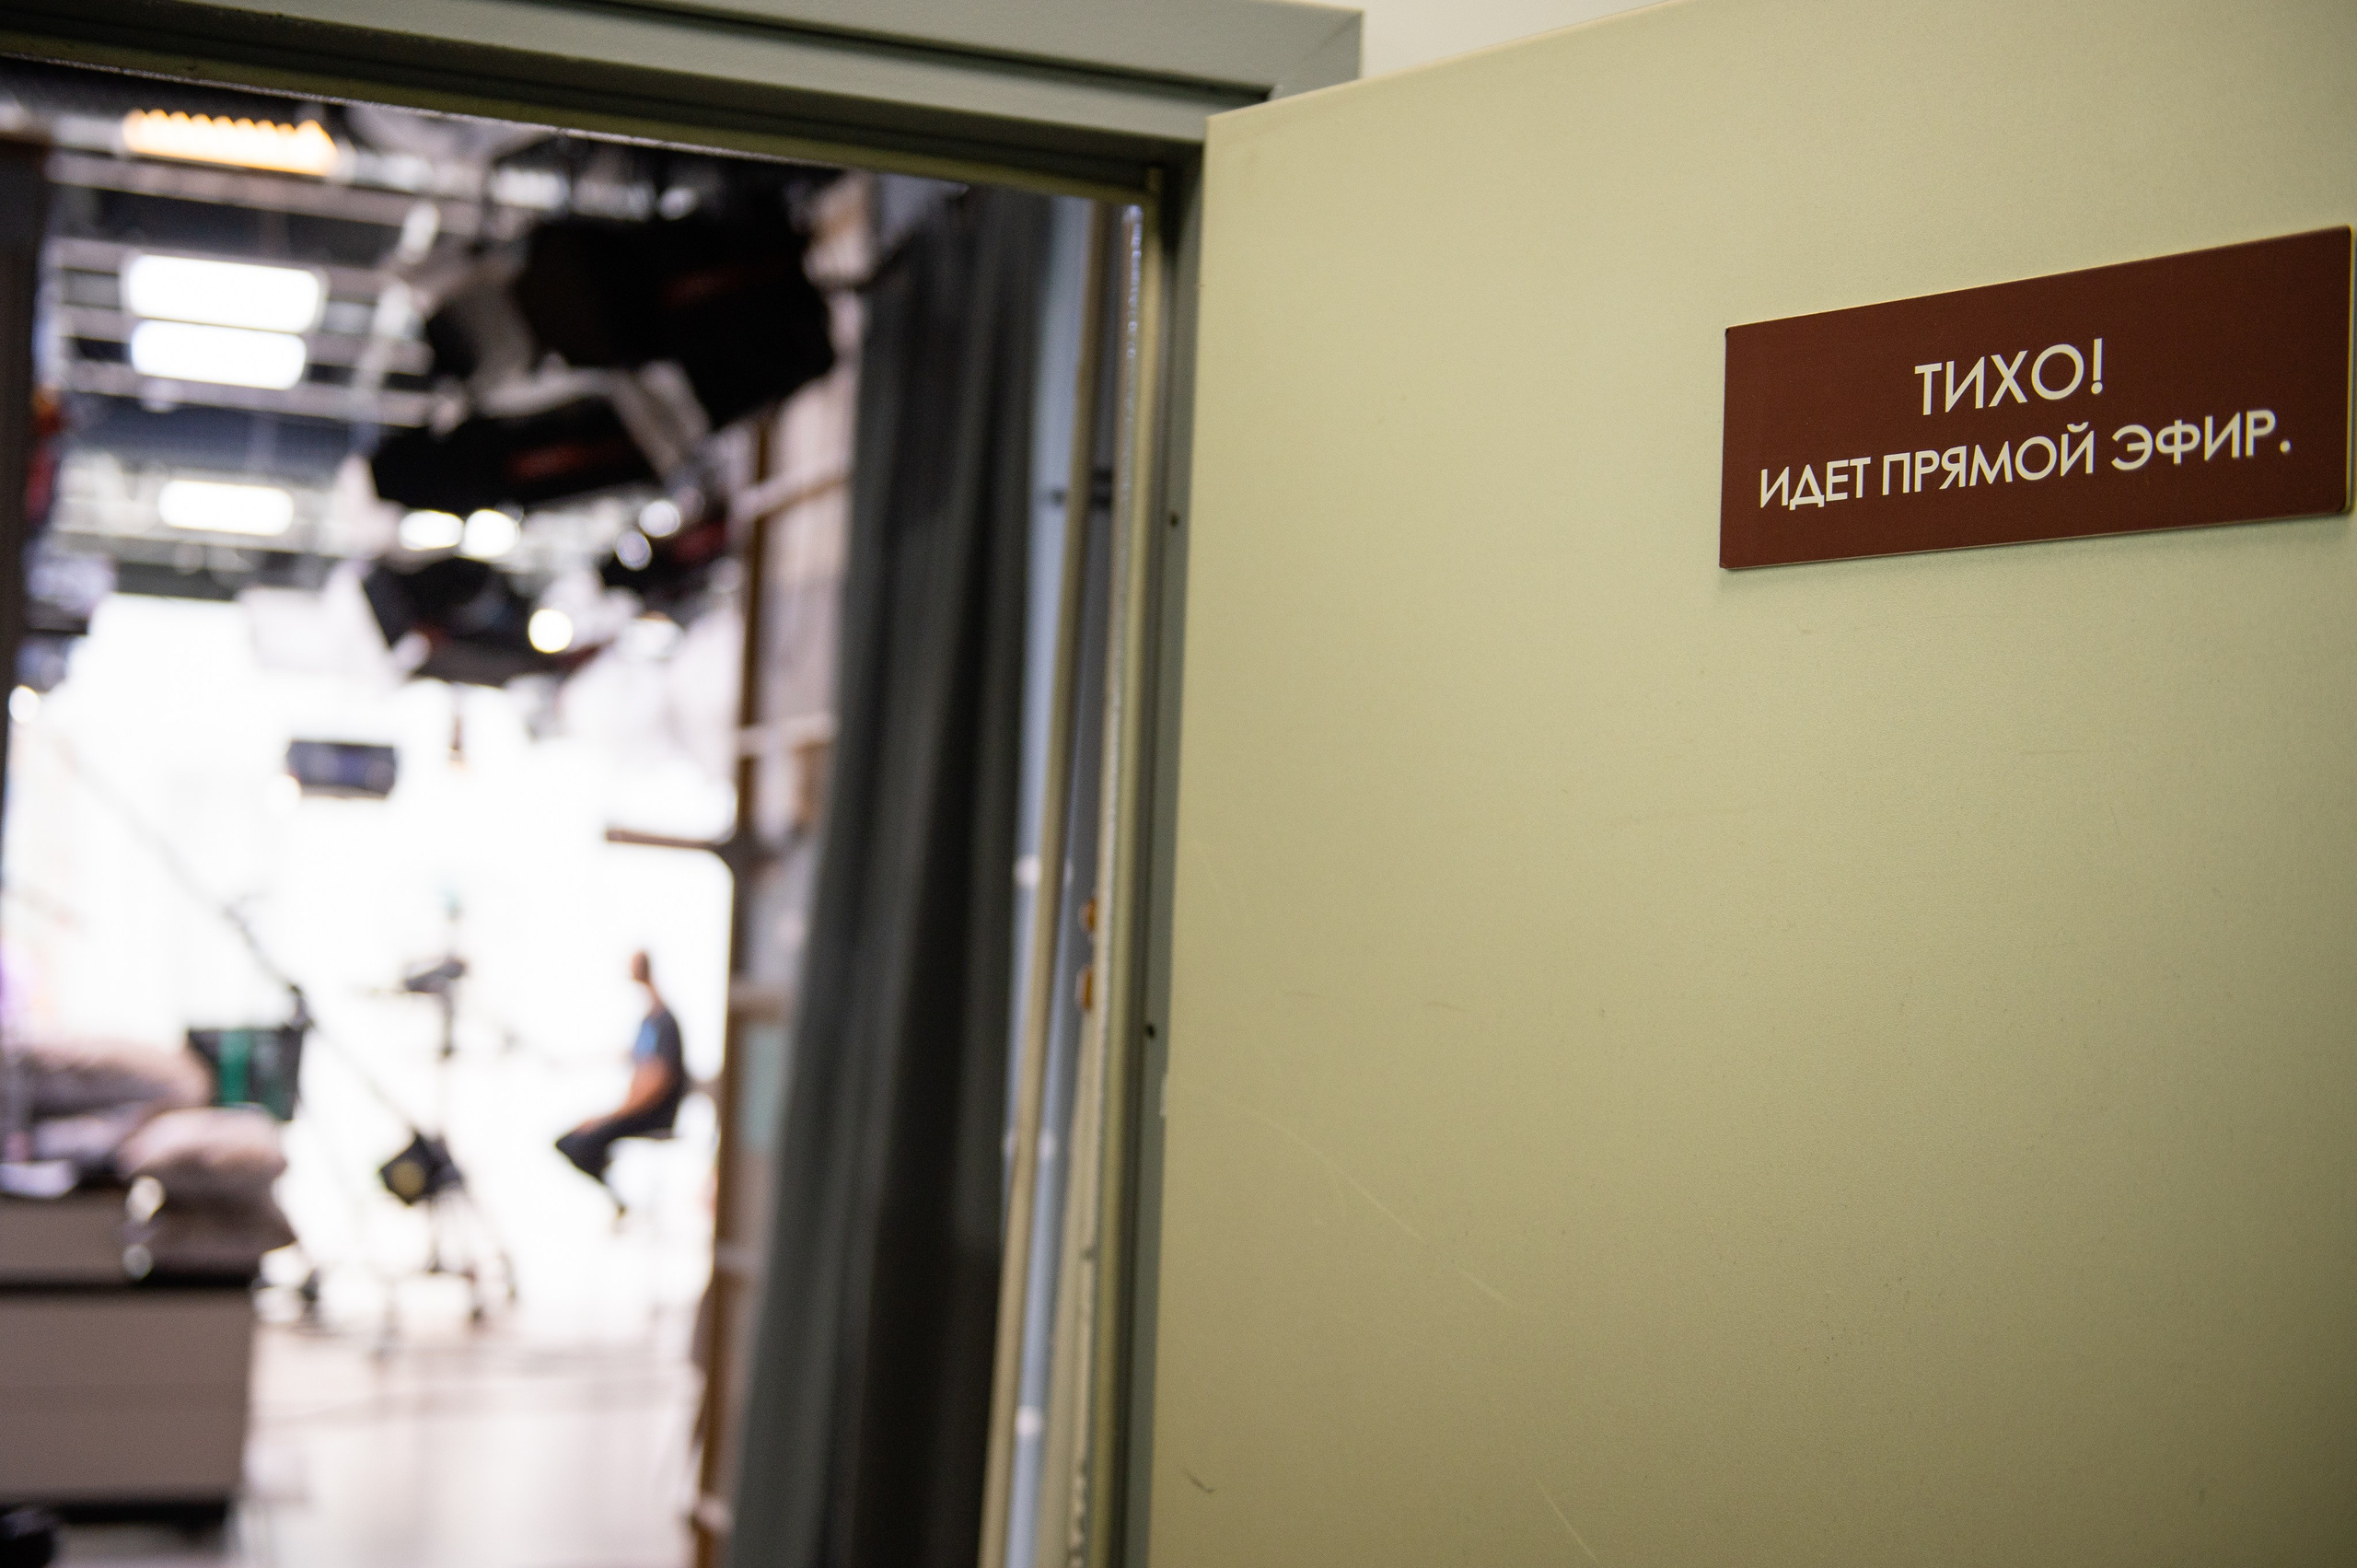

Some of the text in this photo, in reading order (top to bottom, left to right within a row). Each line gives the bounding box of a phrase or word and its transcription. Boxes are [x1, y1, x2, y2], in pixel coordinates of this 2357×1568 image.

[1914, 337, 2104, 415] ТИХО!
[1759, 409, 2292, 511] ИДЕТ ПРЯМОЙ ЭФИР.
